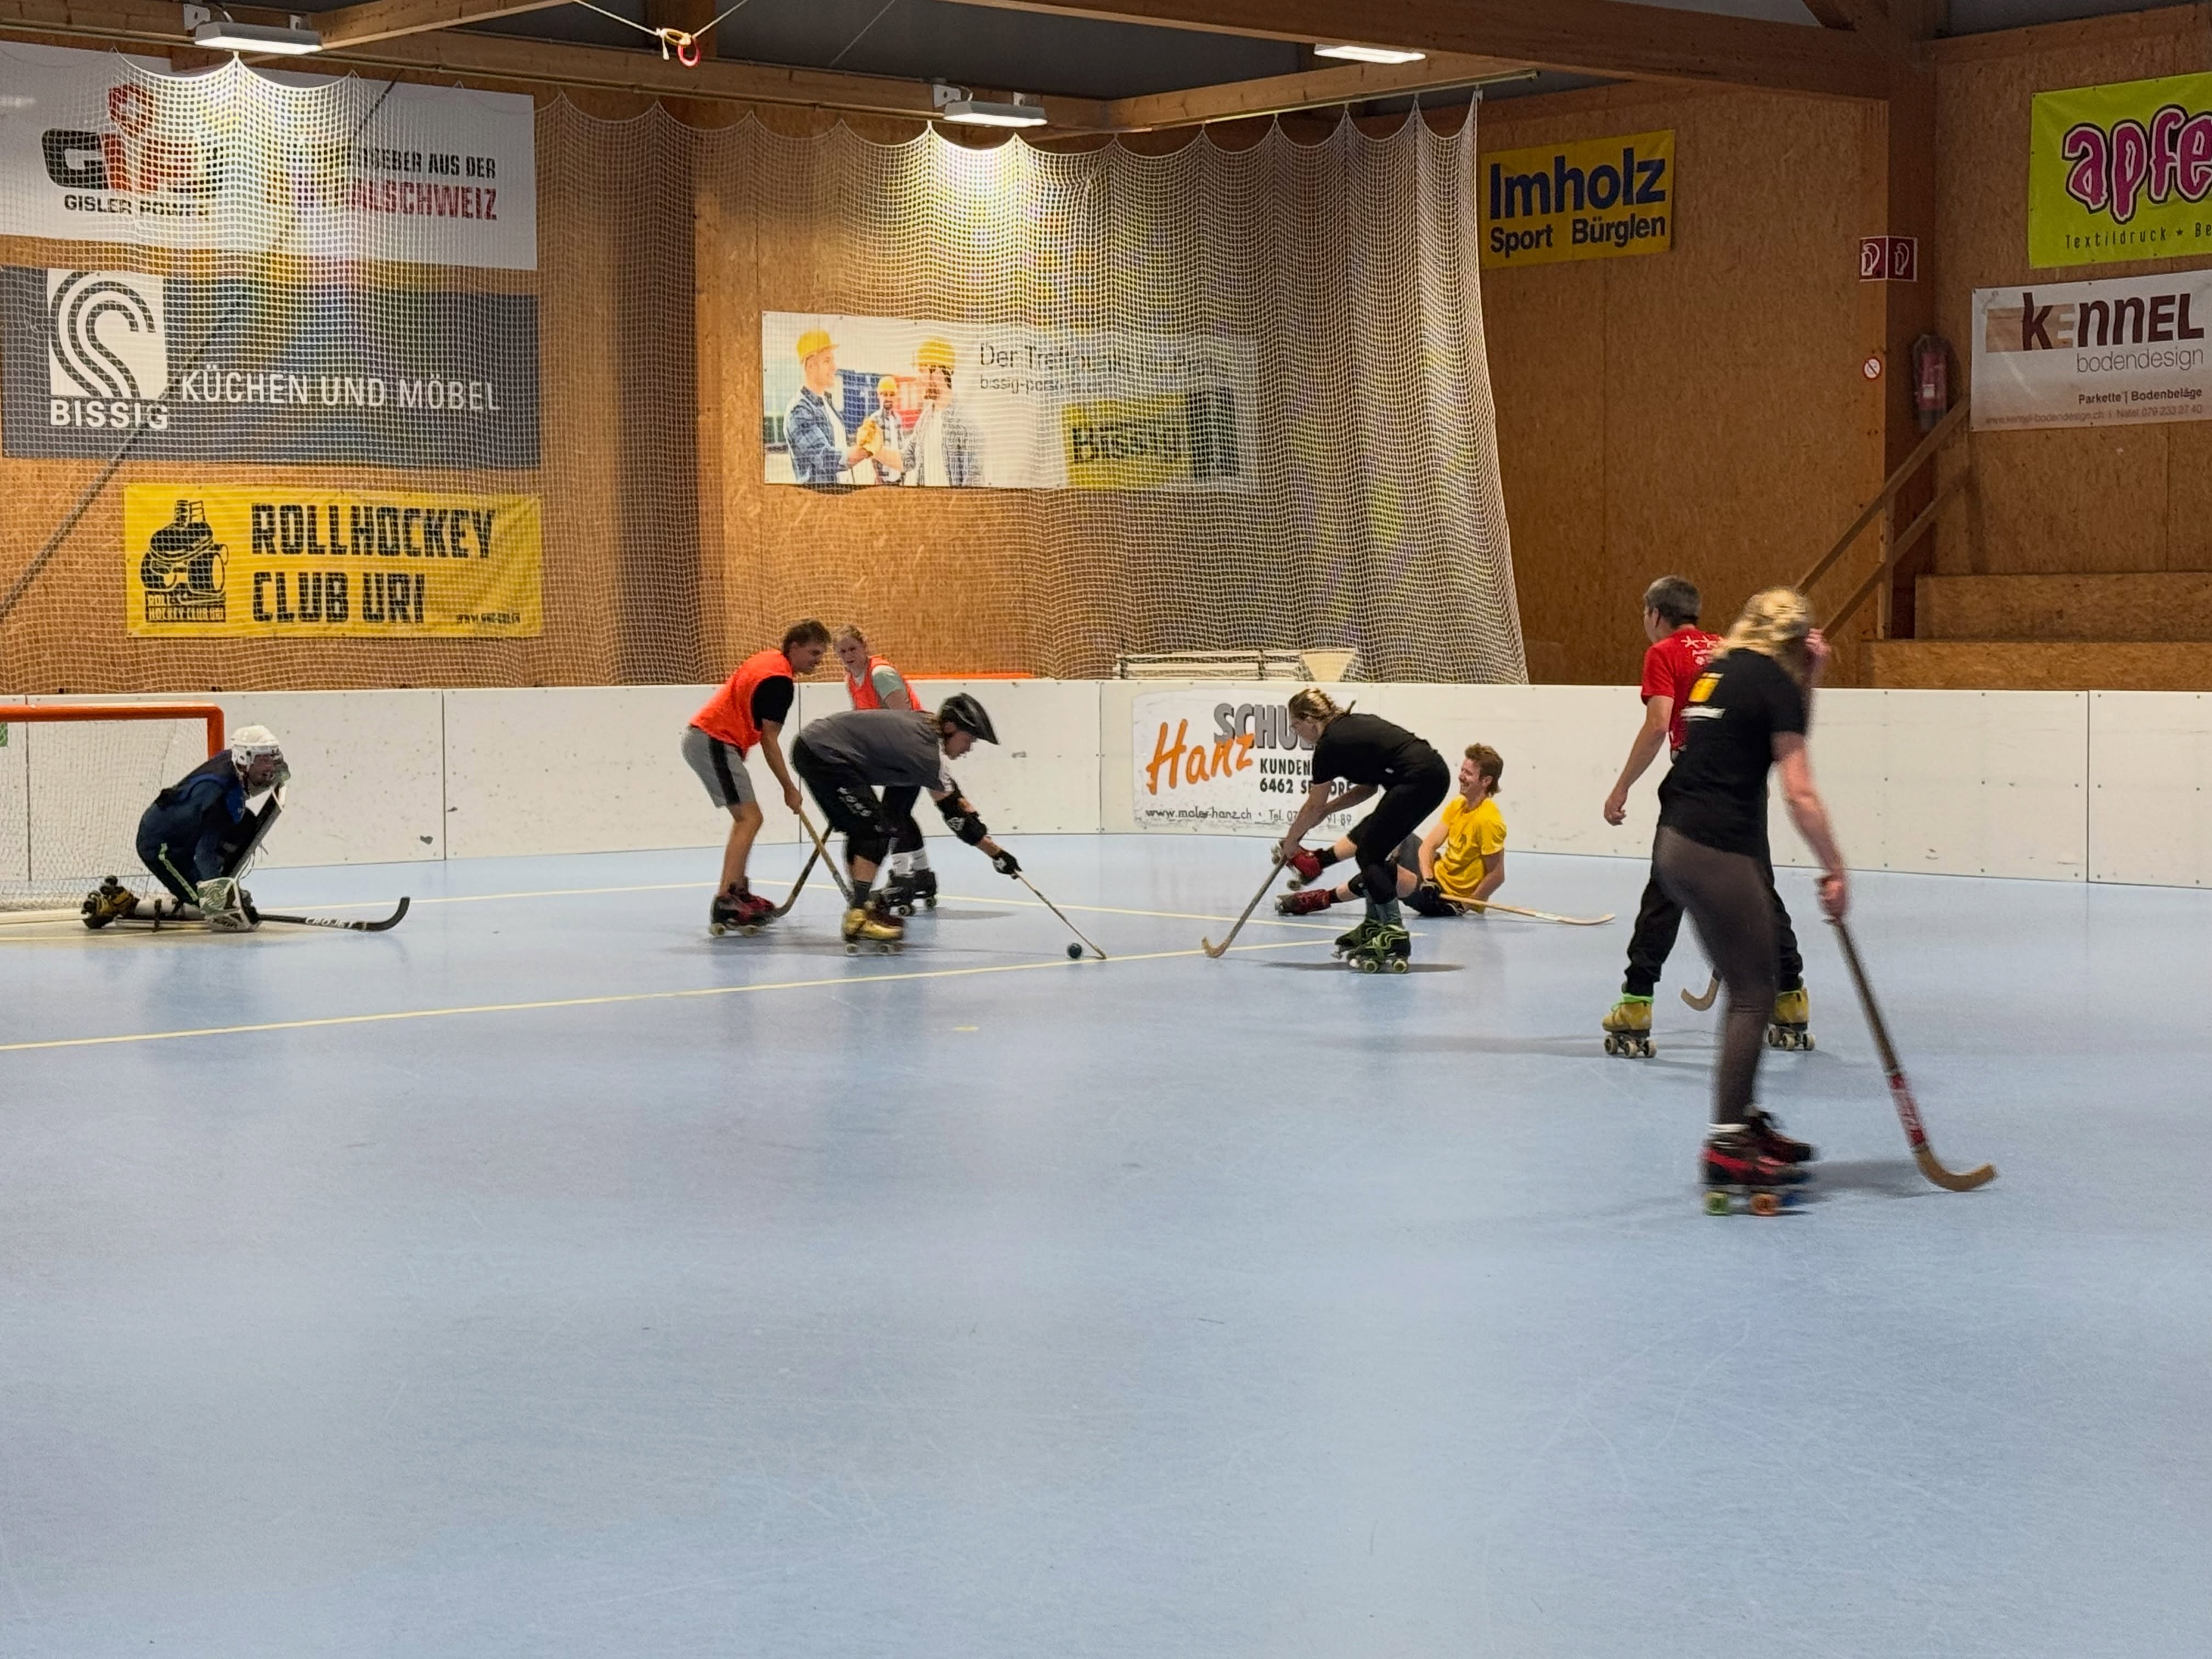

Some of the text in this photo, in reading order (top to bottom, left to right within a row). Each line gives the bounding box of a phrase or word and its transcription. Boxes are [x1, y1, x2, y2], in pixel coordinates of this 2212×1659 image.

[428, 152, 461, 176] AUS
[466, 156, 496, 179] DER
[1490, 147, 1666, 220] Imholz
[64, 194, 132, 215] GISLER
[1490, 213, 1666, 258] Sport Bürglen
[2066, 226, 2166, 249] Textildruck
[979, 342, 1018, 369] Der
[2077, 346, 2204, 373] bodendesign
[182, 364, 500, 410] KÜCHEN UND MÖBEL
[2078, 392, 2121, 405] Parkette
[50, 399, 168, 430] BISSIG
[251, 502, 495, 558] ROLLHOCKEY
[252, 571, 425, 625] CLUB URI
[1214, 703, 1317, 751] SCHU
[1146, 718, 1255, 795] Hanz
[1260, 758, 1311, 776] KUNDEN
[1260, 777, 1293, 794] 6462
